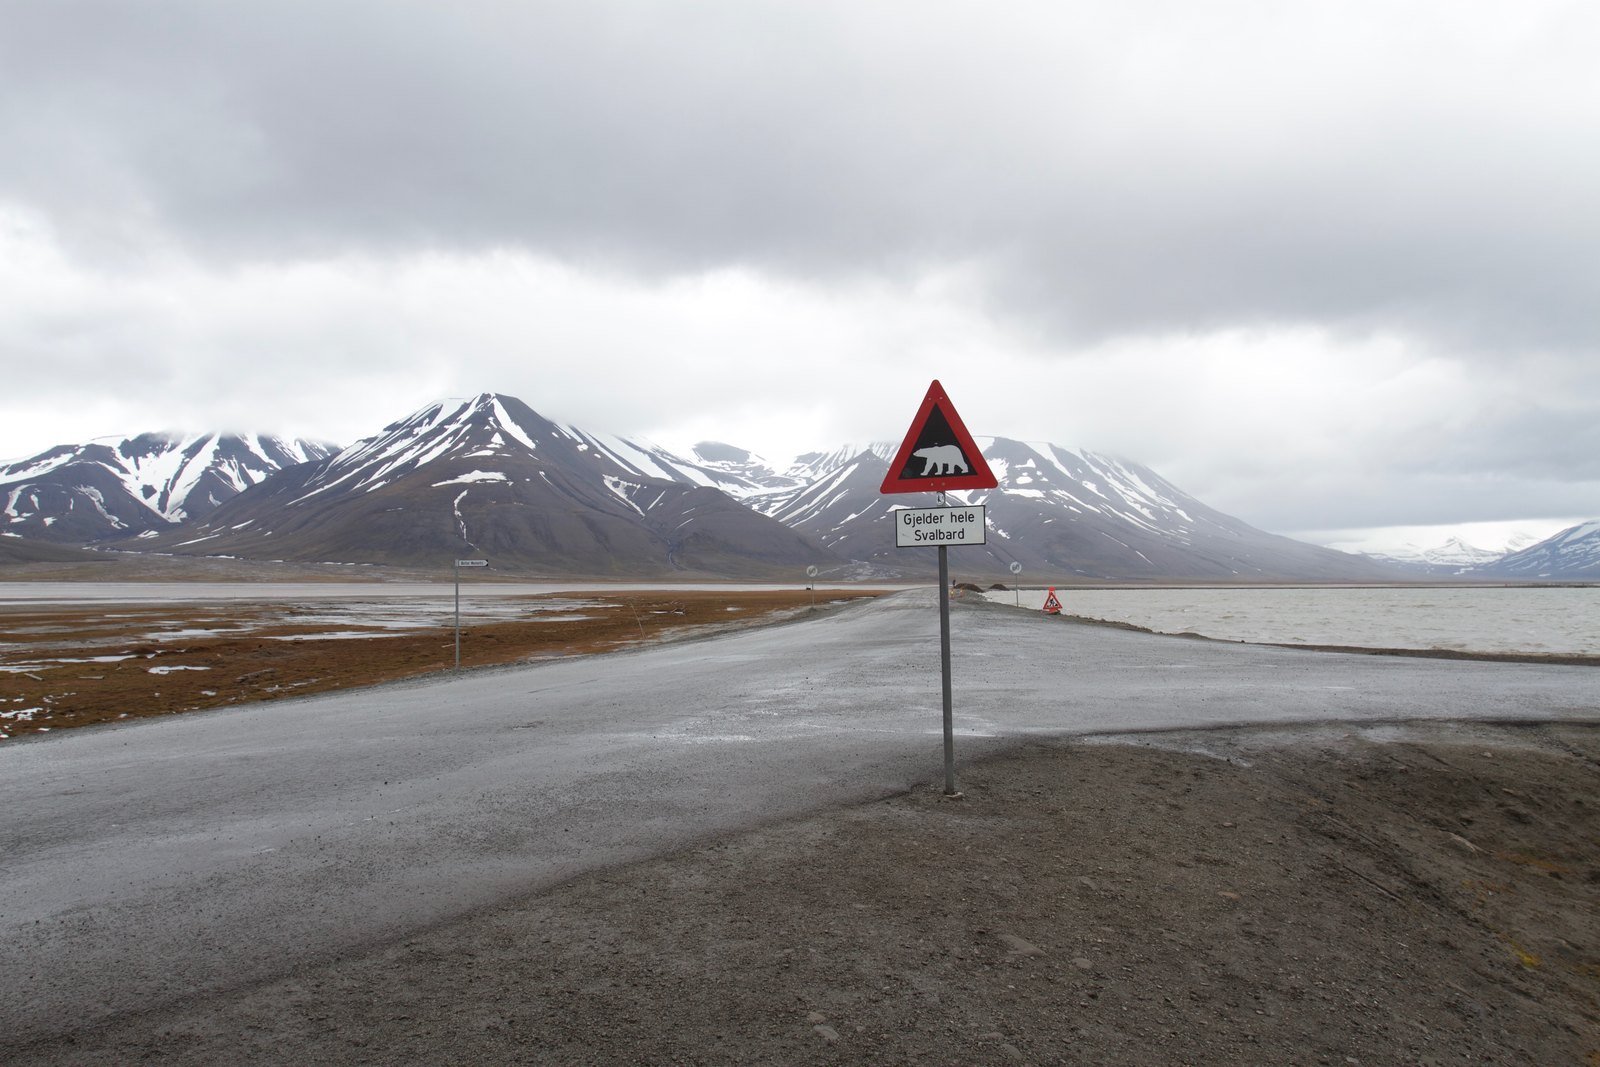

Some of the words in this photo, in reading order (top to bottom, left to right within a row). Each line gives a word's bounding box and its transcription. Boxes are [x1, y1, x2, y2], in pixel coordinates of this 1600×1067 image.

[903, 513, 944, 528] Gjelder
[950, 511, 975, 523] hele
[914, 528, 965, 541] Svalbard
